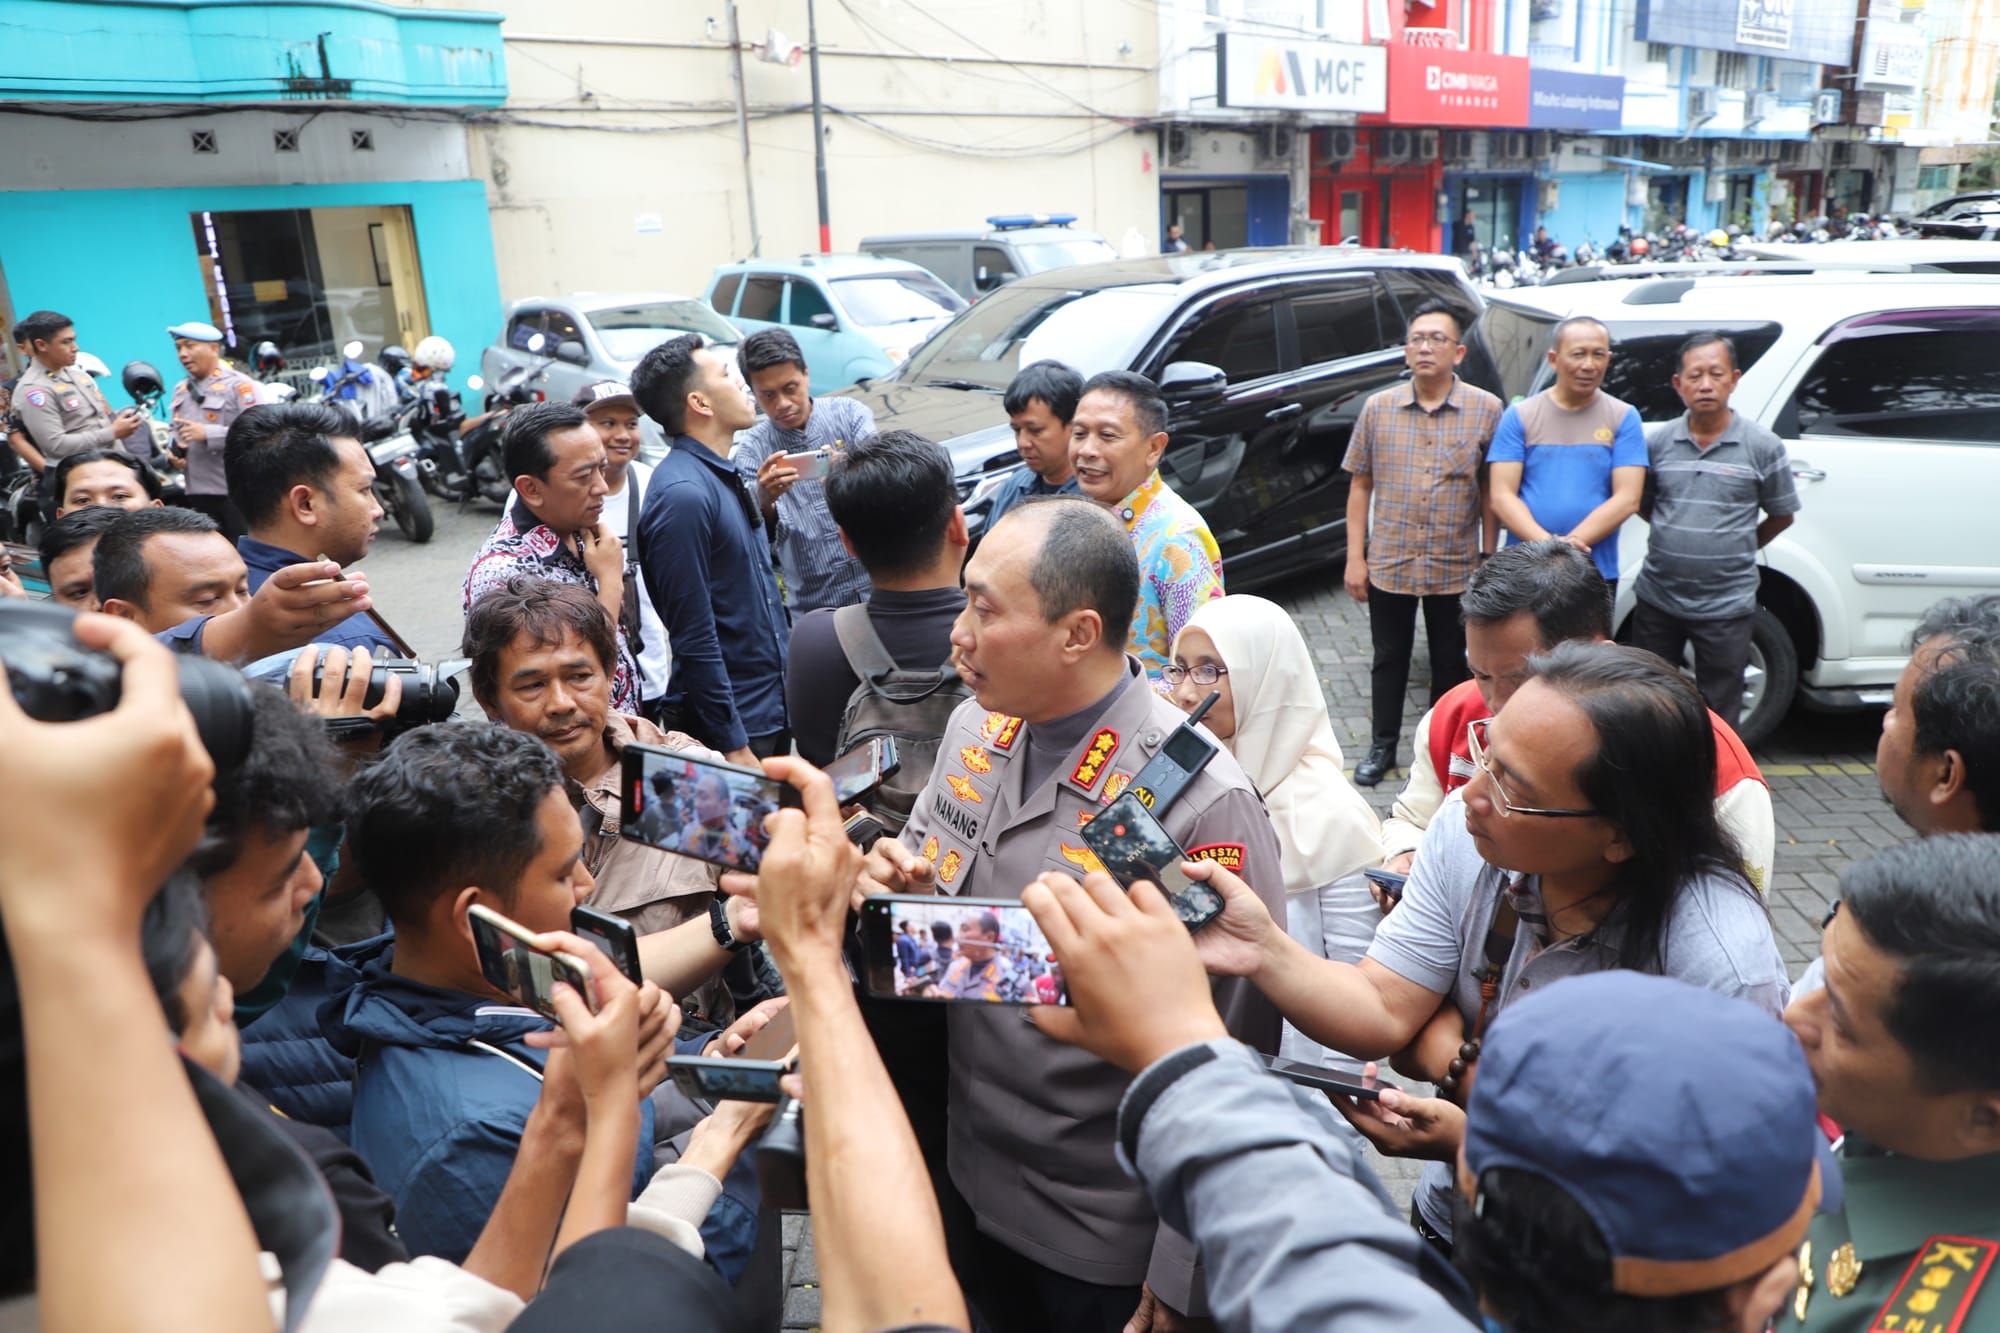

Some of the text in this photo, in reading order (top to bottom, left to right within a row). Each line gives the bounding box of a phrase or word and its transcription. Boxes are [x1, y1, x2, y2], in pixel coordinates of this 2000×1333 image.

[1314, 57, 1365, 95] MCF
[1440, 94, 1498, 108] FINANCE
[934, 794, 977, 839] NANANG
[1188, 847, 1240, 862] LRESTA
[1217, 857, 1239, 866] KOTA
